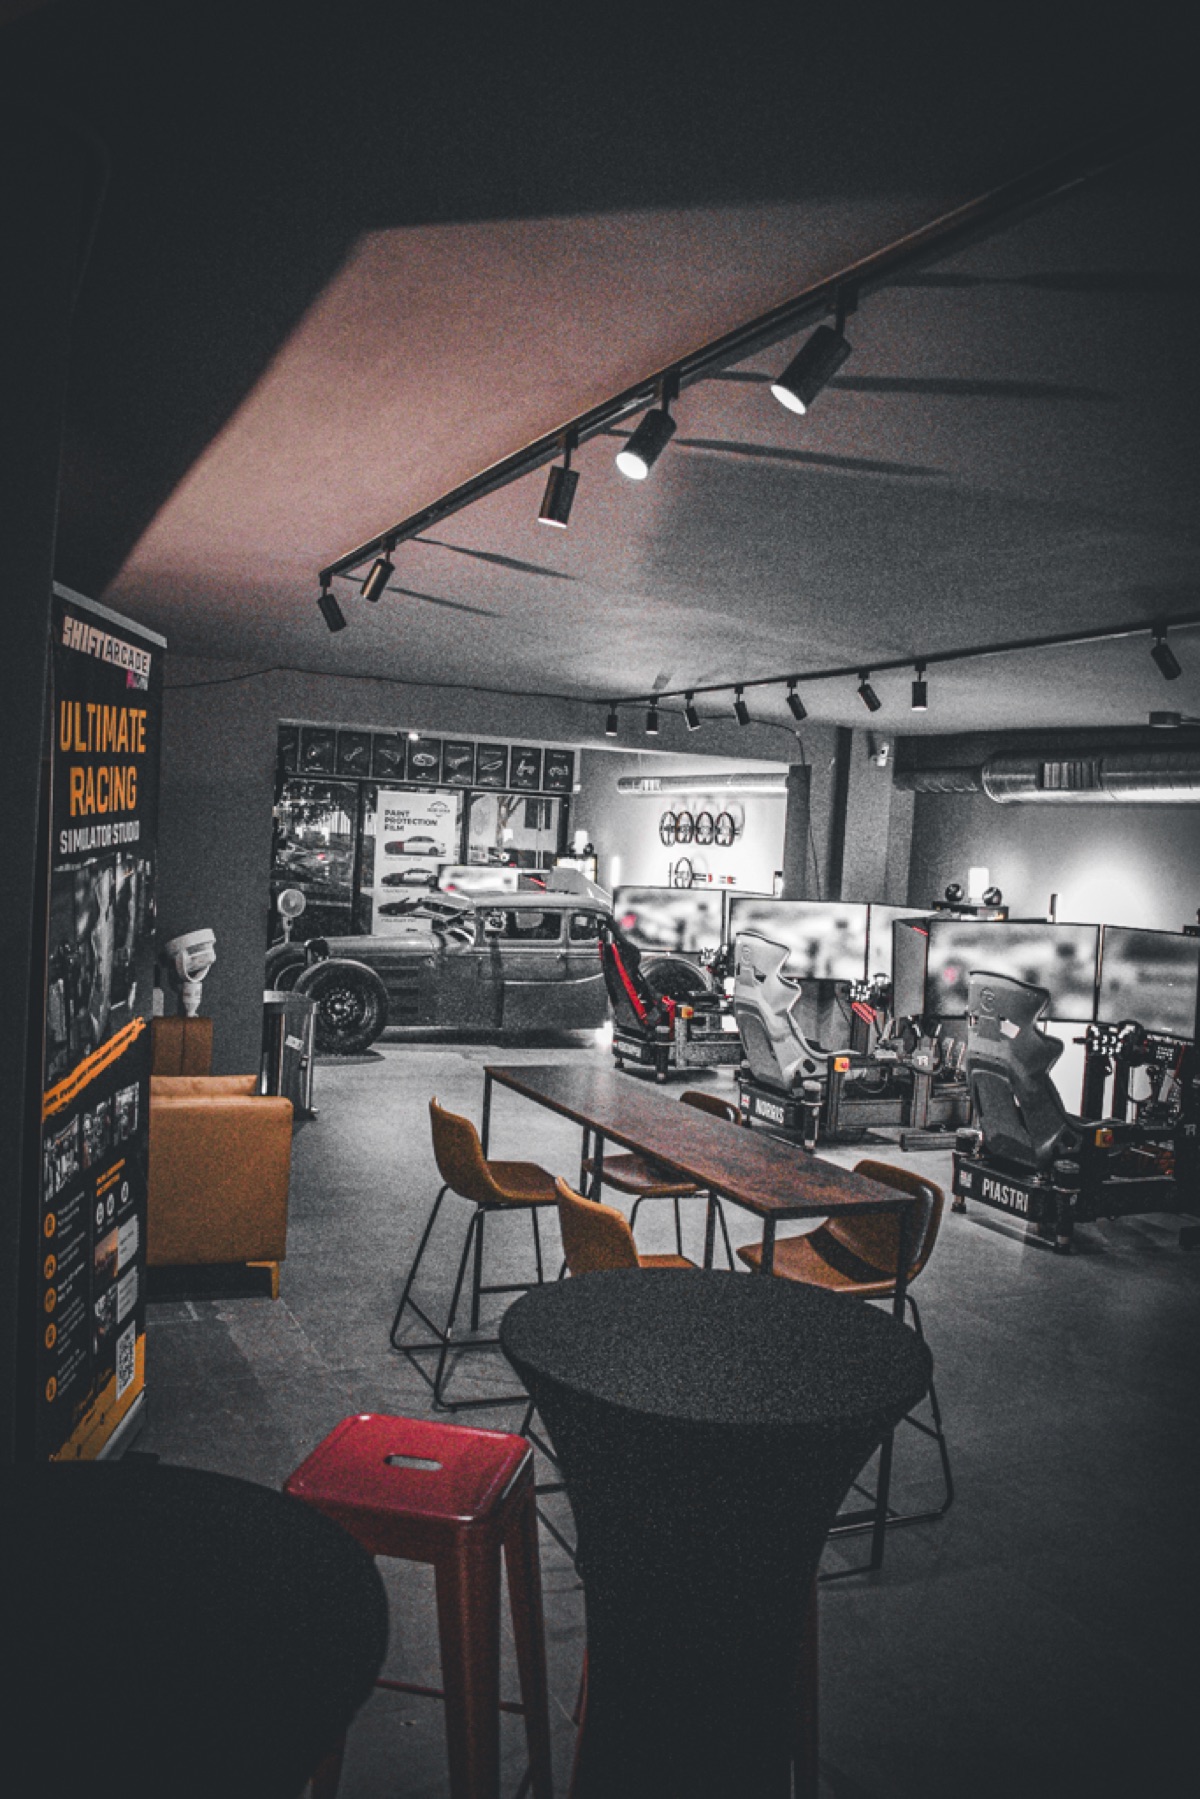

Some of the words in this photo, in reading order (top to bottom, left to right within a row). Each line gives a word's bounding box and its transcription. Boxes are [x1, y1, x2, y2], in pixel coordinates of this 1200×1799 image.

[60, 701, 147, 753] ULTIMATE
[69, 766, 138, 817] RACING
[384, 809, 410, 818] PAINT
[384, 817, 438, 827] PROTECTION
[384, 824, 405, 832] FILM
[60, 824, 112, 854] SIMULATOR
[112, 820, 140, 845] STUDIO
[982, 1177, 1029, 1213] PIASTRI
